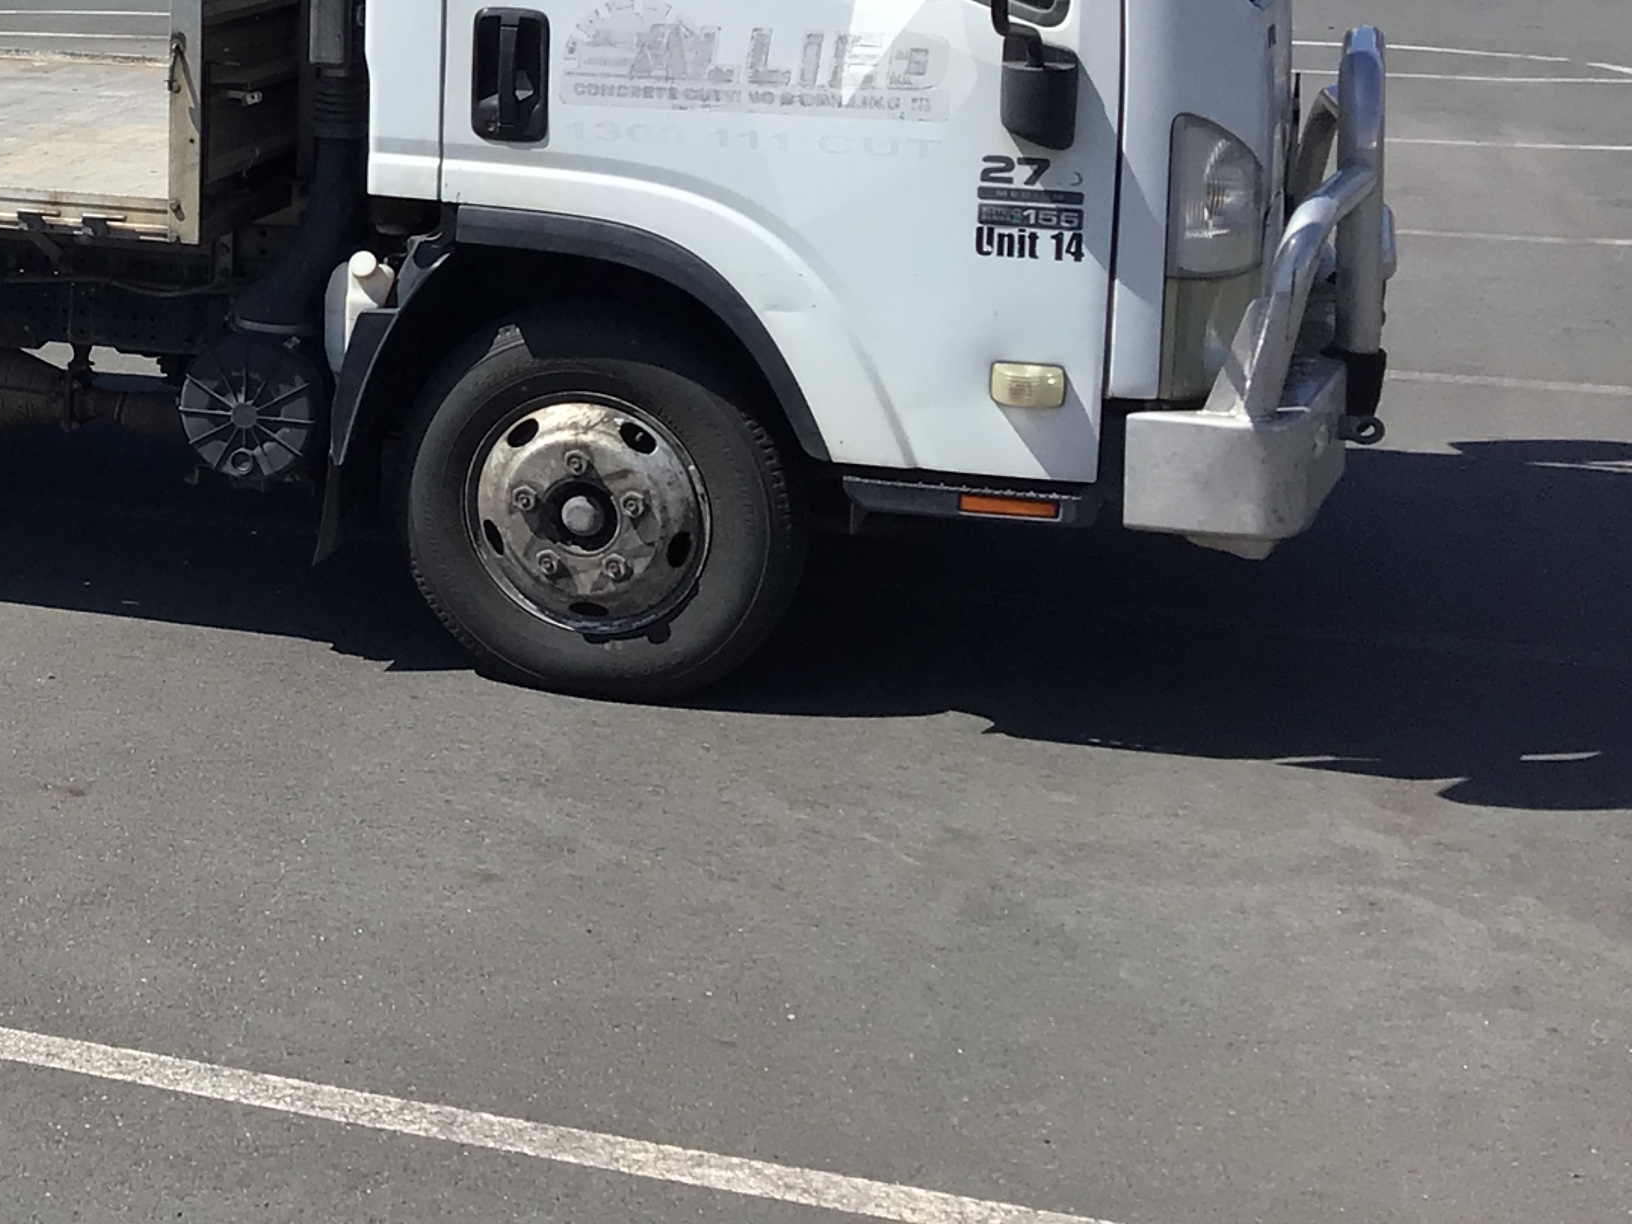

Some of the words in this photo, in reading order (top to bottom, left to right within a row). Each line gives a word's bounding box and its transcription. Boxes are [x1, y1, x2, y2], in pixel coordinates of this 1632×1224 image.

[629, 22, 951, 90] ALLIED
[572, 81, 678, 101] CONCRETE
[565, 119, 687, 146] 1300
[708, 127, 790, 151] 111
[818, 133, 943, 159] CUT
[1023, 209, 1079, 228] 155
[975, 226, 1040, 260] Unit
[1050, 231, 1085, 263] 14
